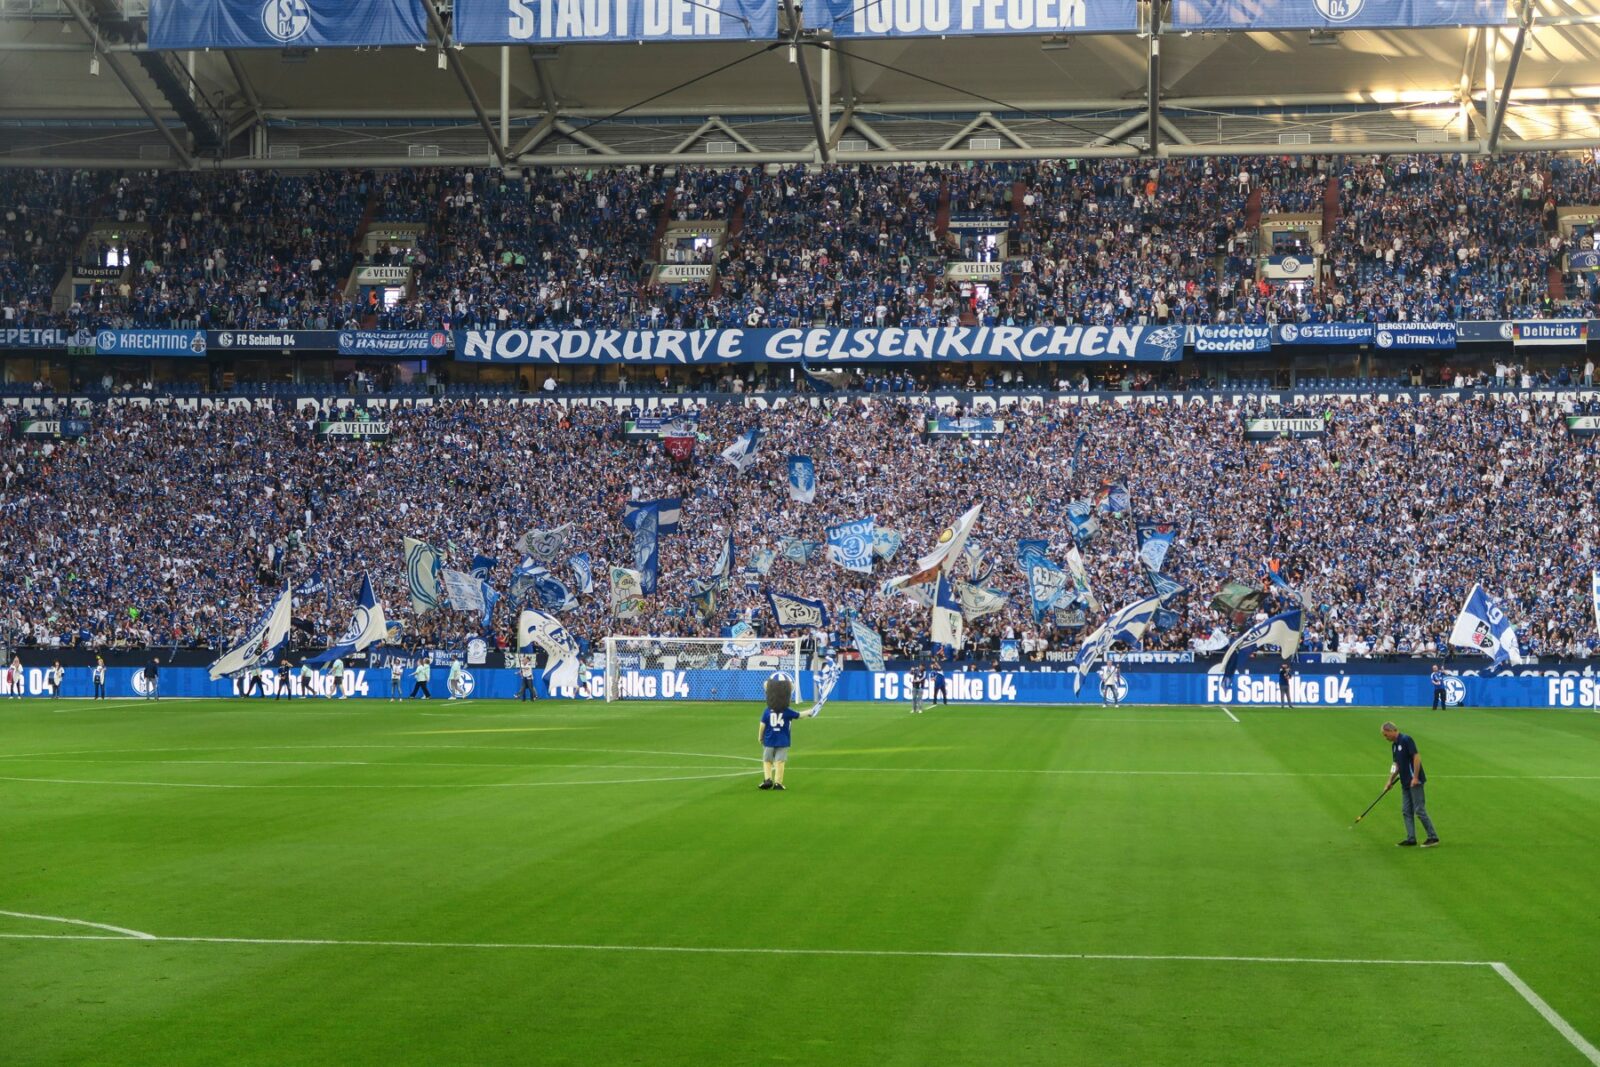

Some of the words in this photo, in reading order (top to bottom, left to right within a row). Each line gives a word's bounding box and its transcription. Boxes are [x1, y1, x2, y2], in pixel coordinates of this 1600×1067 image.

[508, 0, 628, 39] STADT
[643, 0, 721, 36] DER
[373, 268, 409, 277] VELTINS
[675, 267, 711, 276] VELTINS
[964, 264, 1001, 273] VELTINS
[1377, 321, 1456, 331] BERGSTADTKNAPPEN
[1523, 324, 1577, 337] Delbrück
[120, 333, 188, 349] KRECHTING
[236, 335, 247, 346] FC
[249, 334, 281, 346] Schalke
[283, 334, 295, 346] 04
[355, 338, 429, 349] HAMBURG
[1396, 332, 1435, 344] RÜTHEN
[463, 328, 744, 364] NORDKURVE
[765, 326, 1144, 361] GELSENKIRCHEN
[344, 423, 388, 434] VELTINS
[1272, 419, 1319, 431] VELTINS
[579, 671, 656, 697] Scalke
[661, 671, 689, 698] 04
[874, 673, 898, 700] FC
[988, 673, 1017, 700] 04
[1324, 676, 1354, 704] 04
[1549, 678, 1574, 706] FC
[770, 712, 785, 728] 04
